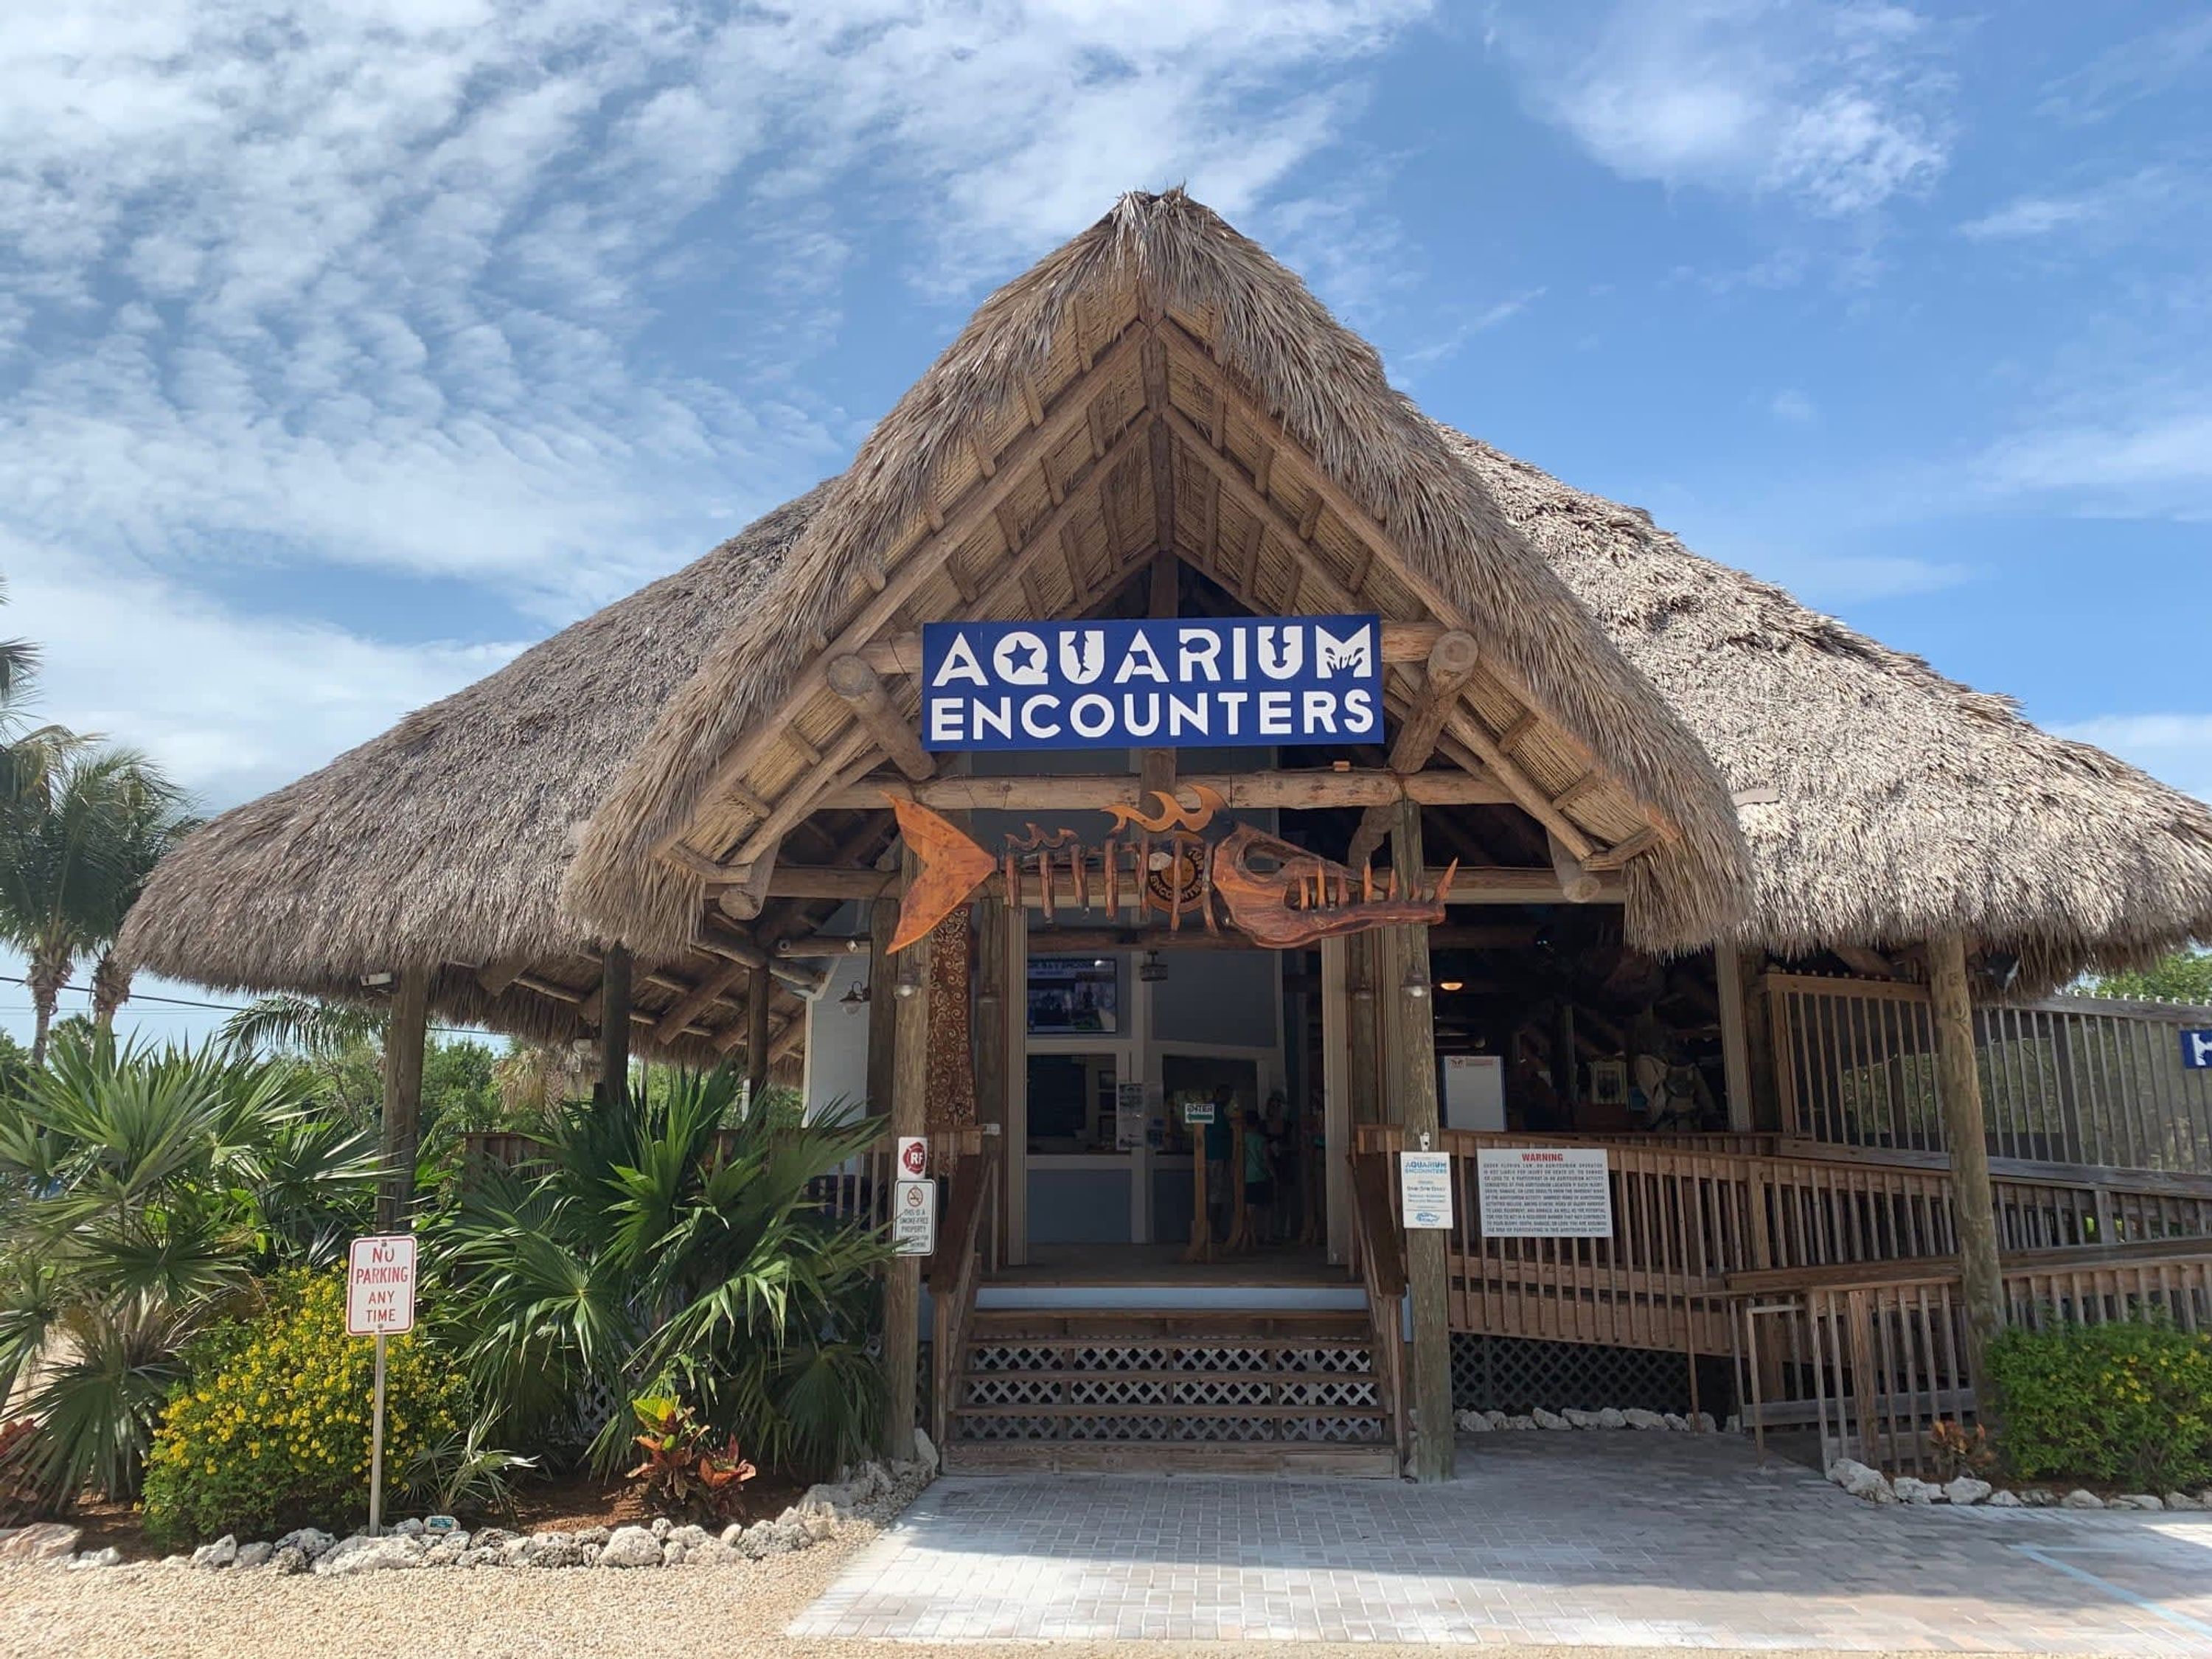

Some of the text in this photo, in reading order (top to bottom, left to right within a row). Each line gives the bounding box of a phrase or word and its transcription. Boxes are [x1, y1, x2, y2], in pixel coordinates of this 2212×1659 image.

[932, 623, 1371, 686] AQUARIUM
[932, 688, 1374, 740] ENCOUNTERS
[1187, 1105, 1212, 1113] ENTER
[1522, 1153, 1563, 1162] WARNING
[1405, 1161, 1447, 1169] AQUARIUM
[902, 1225, 926, 1234] PROPERTY
[356, 1266, 408, 1284] PARKING
[369, 1290, 395, 1304] ANY
[366, 1309, 396, 1324] TIME
